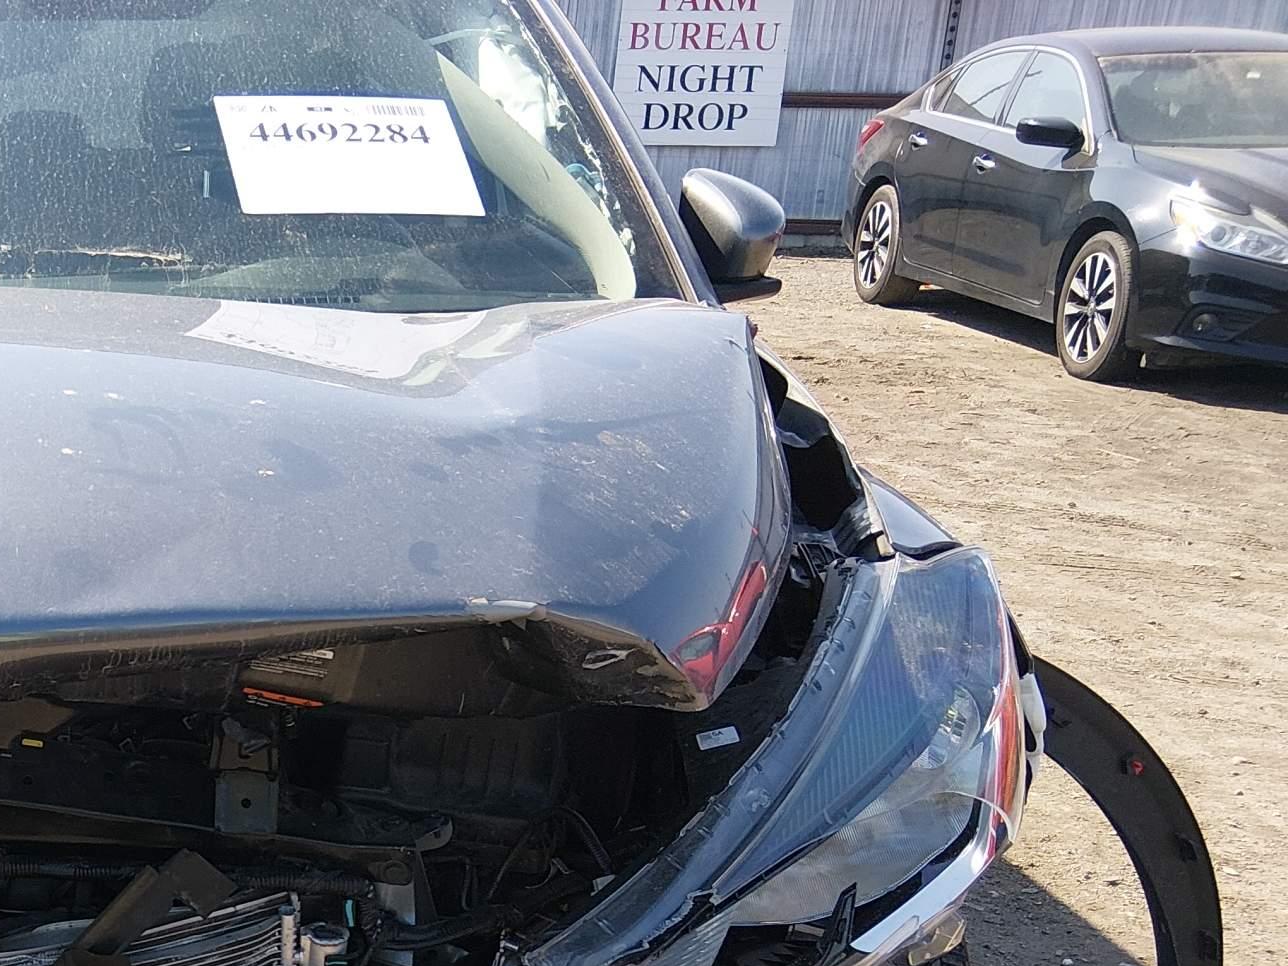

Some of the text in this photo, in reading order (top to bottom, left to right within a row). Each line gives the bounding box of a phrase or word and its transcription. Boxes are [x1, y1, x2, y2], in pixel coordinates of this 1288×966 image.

[628, 22, 781, 51] BUREAU
[637, 64, 763, 93] NIGHT
[641, 102, 749, 131] DROP
[249, 122, 431, 144] 44692284
